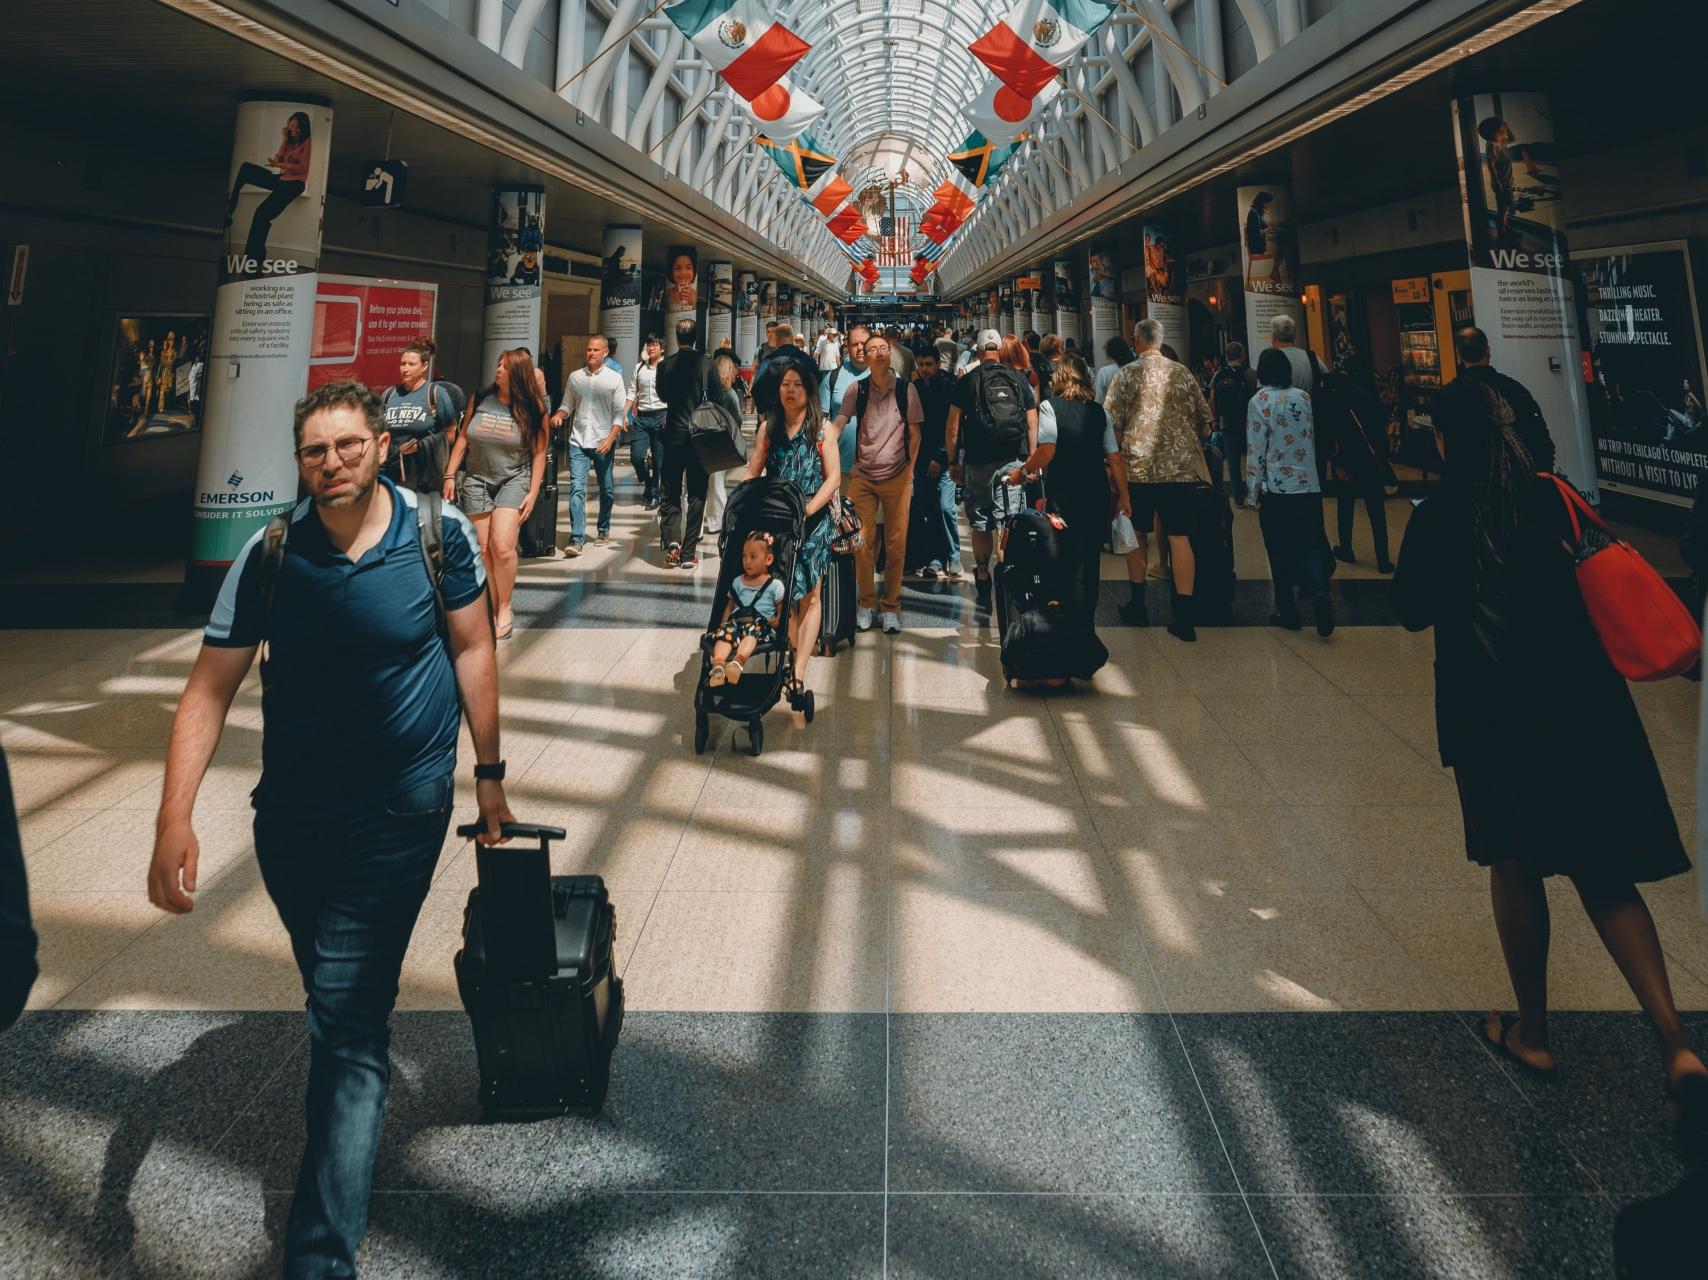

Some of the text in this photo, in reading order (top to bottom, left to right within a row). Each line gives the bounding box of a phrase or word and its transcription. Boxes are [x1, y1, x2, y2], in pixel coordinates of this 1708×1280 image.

[227, 254, 298, 274] We see
[1490, 249, 1564, 269] We see
[490, 287, 532, 299] We see
[1252, 281, 1273, 292] We
[1599, 285, 1657, 300] THRILLING MUSIC.
[607, 297, 636, 306] We see
[1151, 293, 1167, 303] We
[1599, 308, 1630, 322] DAZZLIN
[384, 409, 427, 422] AL NEVA
[1598, 438, 1708, 469] NO TRIP TO CHICAGO IS COMPLETE
[1600, 457, 1636, 478] WITHOUT
[1638, 464, 1645, 480] A
[1644, 465, 1667, 485] VISIT
[1669, 469, 1681, 488] TO
[200, 491, 274, 504] EMERSON
[192, 507, 284, 519] NSIDER IT SOLVED
